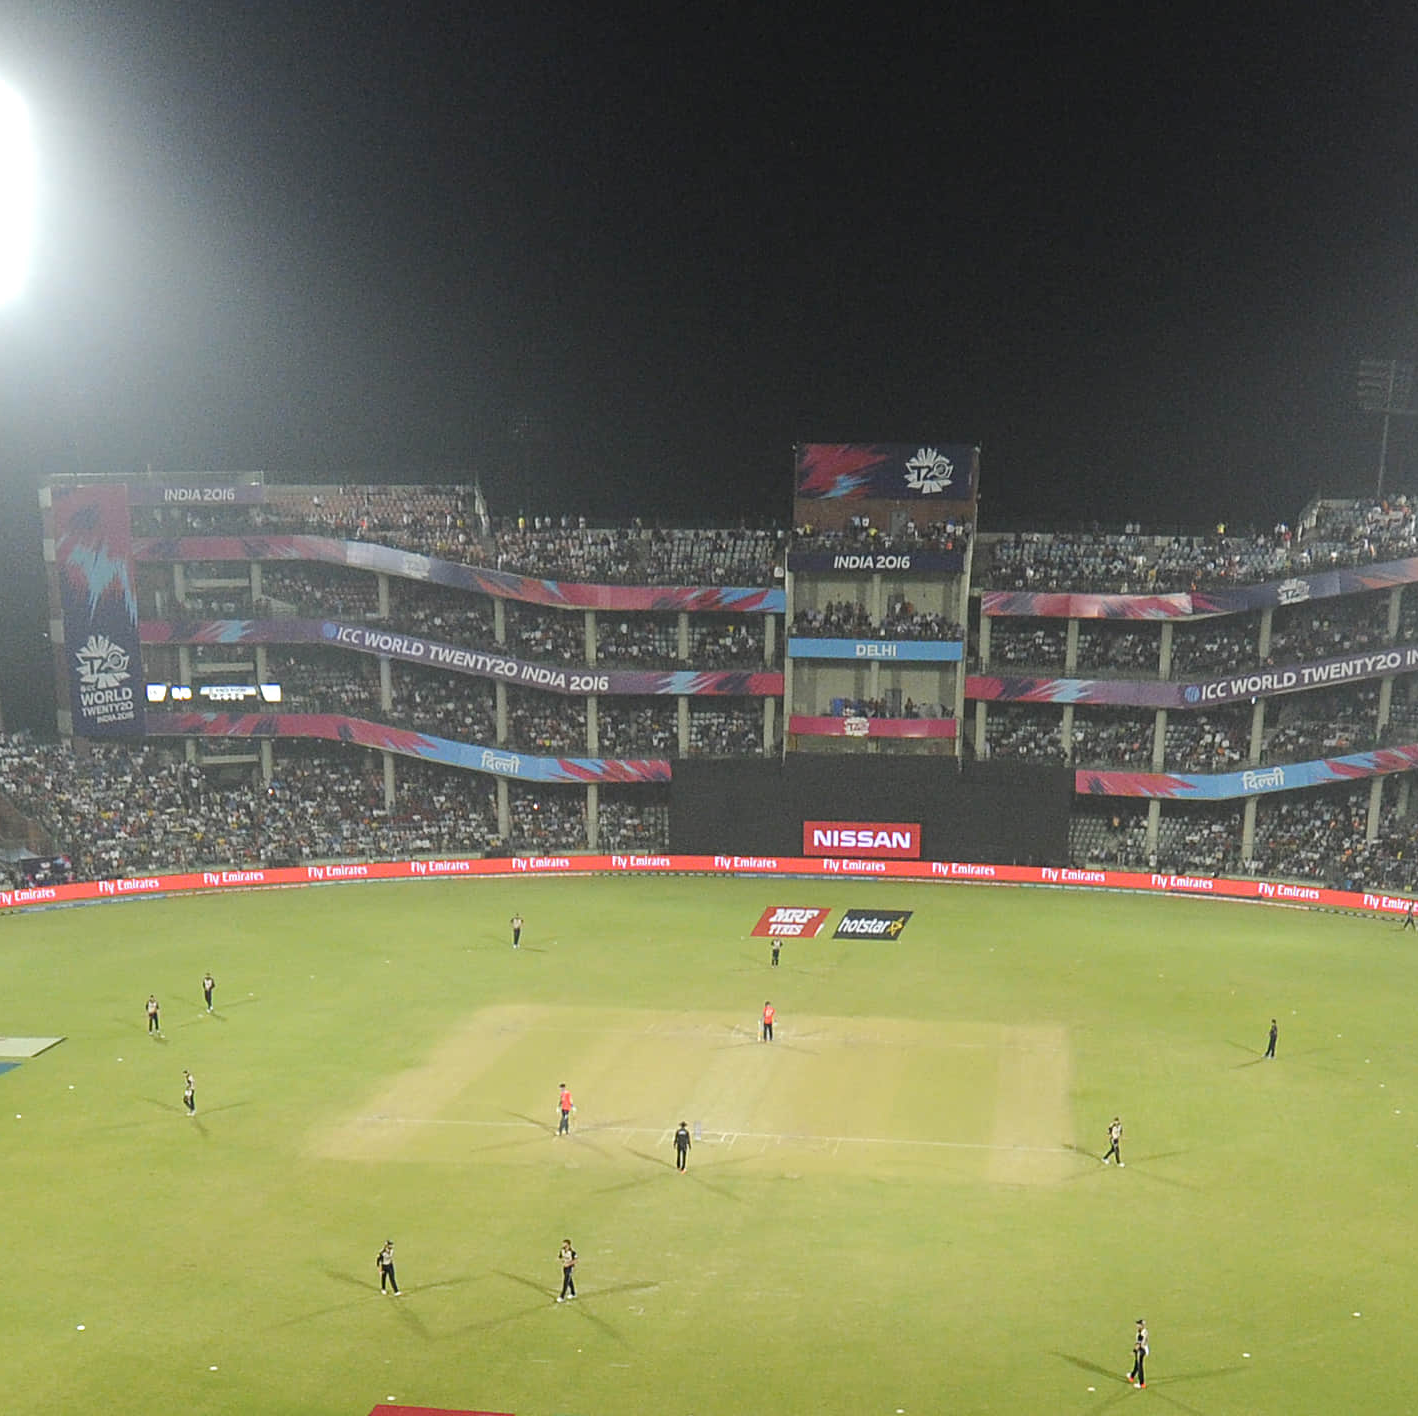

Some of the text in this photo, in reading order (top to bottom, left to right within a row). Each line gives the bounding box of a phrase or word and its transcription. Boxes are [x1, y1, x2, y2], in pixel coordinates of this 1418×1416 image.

[164, 487, 235, 501] INDIA 2016
[834, 555, 910, 569] INDIA 2016
[856, 644, 897, 657] DELHI
[337, 626, 609, 691] ICC WORLD TWENTY20 INDIA 2016
[1201, 677, 1225, 701] ICC
[1229, 668, 1296, 696] WORLD
[1300, 650, 1400, 688] TWENTY20
[81, 688, 133, 706] WORLD
[482, 750, 521, 774] दिल्ली
[1242, 767, 1285, 790] दिल्ली
[813, 829, 911, 849] NISSAN
[410, 859, 470, 875] Fly Emirates
[512, 856, 570, 871] Fly Emirates
[612, 855, 671, 869] Fly Emirates
[714, 856, 777, 870] Fly Emirates
[823, 858, 886, 873] Fly Emirates
[932, 862, 996, 876] Fly Emirates
[203, 871, 264, 886] Fly Emirates
[307, 865, 367, 880] Fly Emirates
[1042, 867, 1106, 882] Fly Emirates
[99, 879, 159, 895] Fly Emirates
[1151, 874, 1213, 890] Fly Emirates
[14, 886, 56, 902] Emirates
[1257, 883, 1320, 900] Fly Emirates
[1364, 894, 1378, 909] Fly
[769, 908, 820, 923] MRF
[768, 923, 804, 935] TYRES
[840, 917, 891, 934] hotstar
